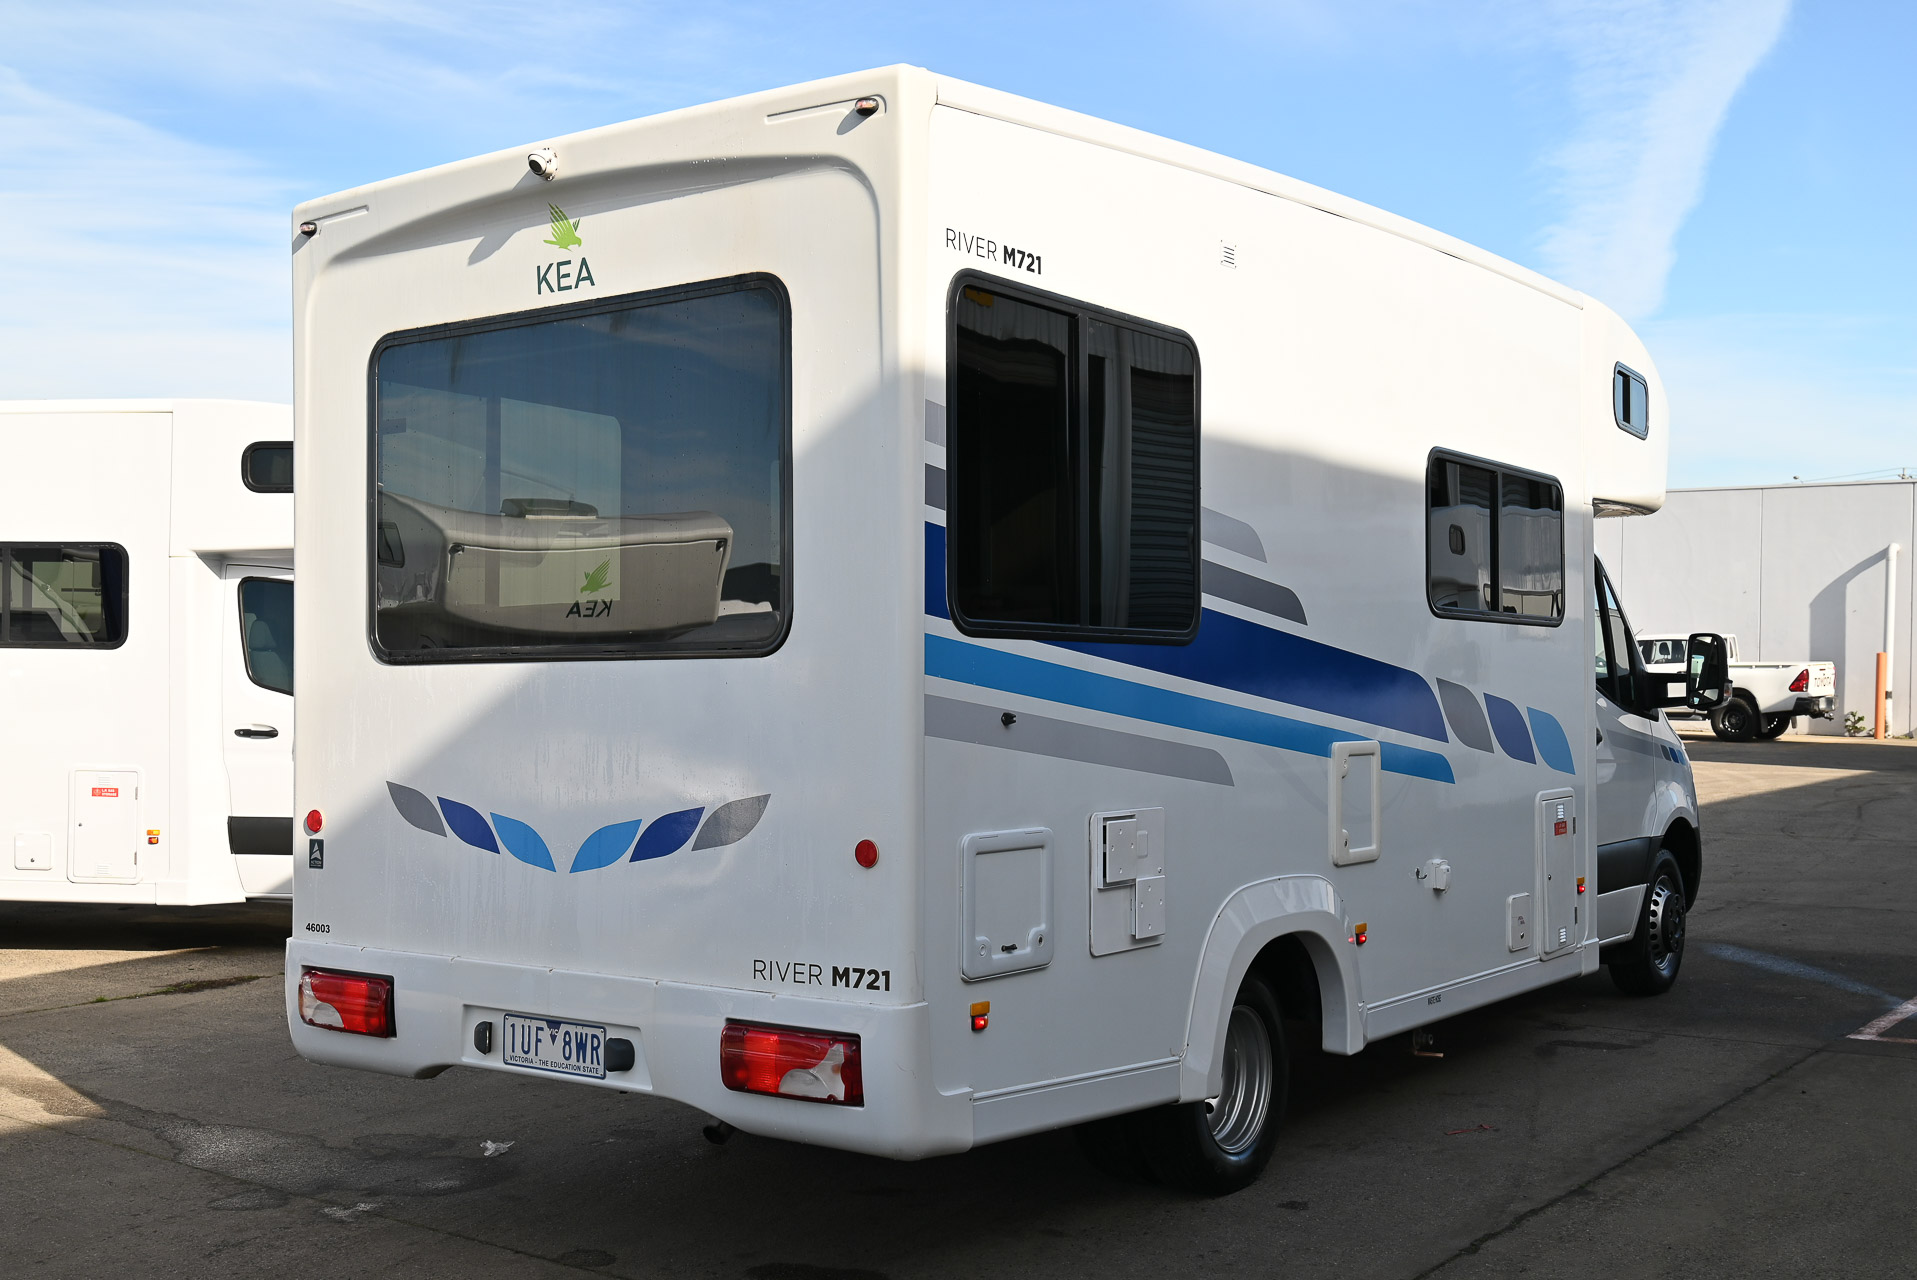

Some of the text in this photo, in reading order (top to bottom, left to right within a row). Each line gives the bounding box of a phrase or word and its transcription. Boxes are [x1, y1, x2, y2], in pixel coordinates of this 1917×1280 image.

[946, 227, 1042, 275] RIVER M721
[536, 257, 596, 295] KEA
[305, 922, 331, 934] 46003
[753, 959, 891, 992] RIVER M721
[510, 1022, 601, 1066] 1UF 8WR
[510, 1054, 534, 1065] VICTORIA
[539, 1059, 550, 1067] THE
[550, 1060, 581, 1072] EDUCATION
[582, 1066, 600, 1075] STATE
